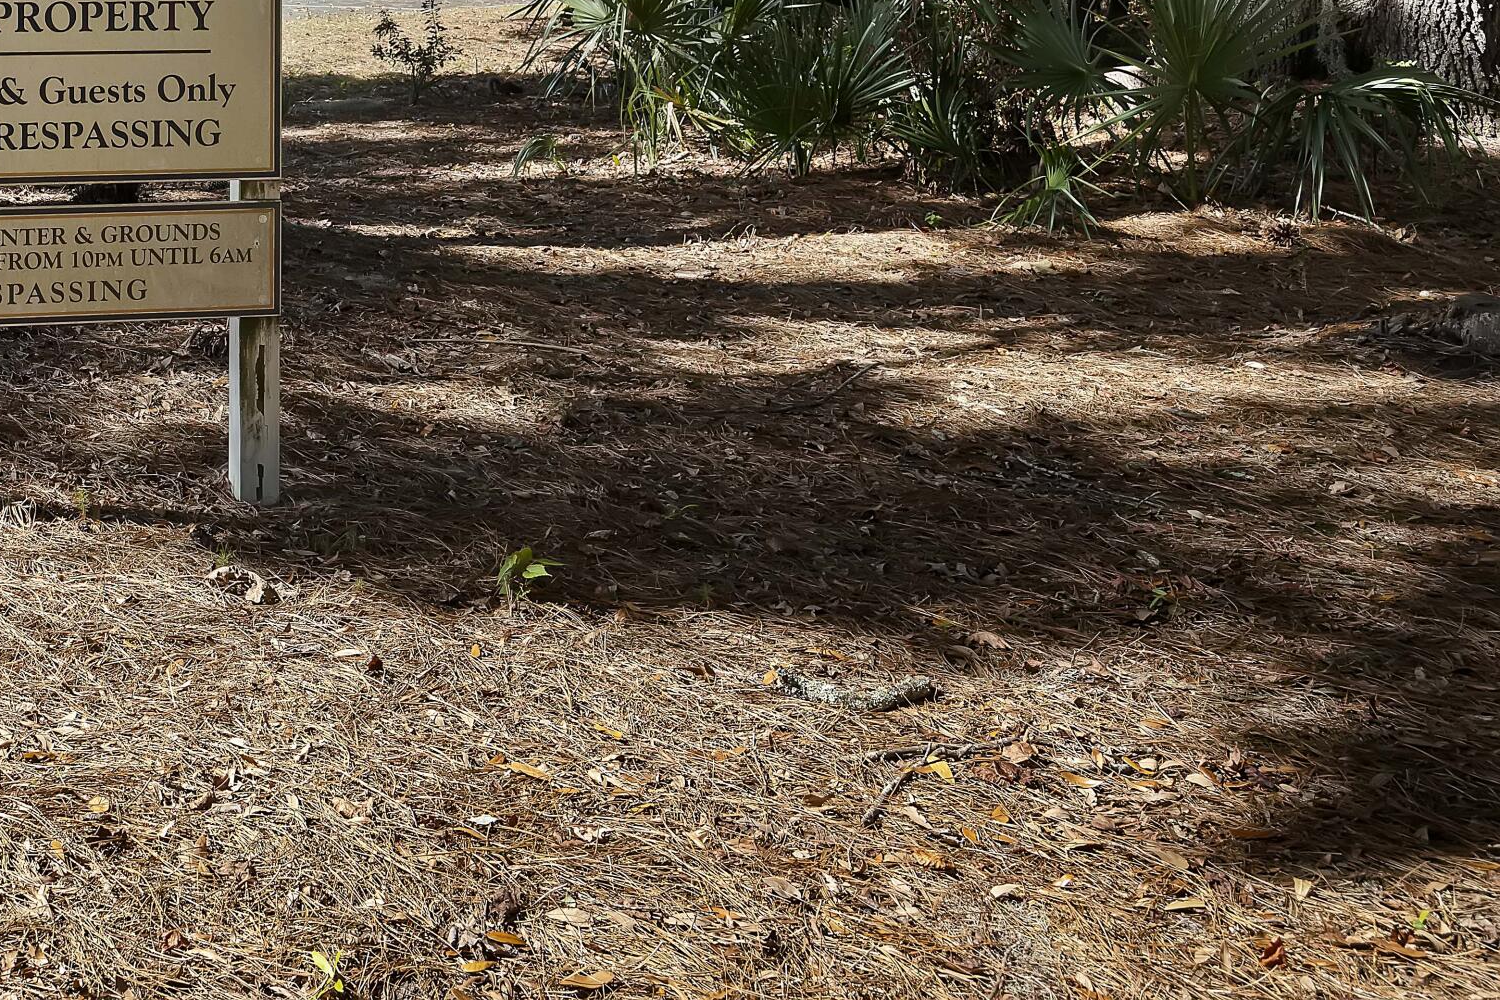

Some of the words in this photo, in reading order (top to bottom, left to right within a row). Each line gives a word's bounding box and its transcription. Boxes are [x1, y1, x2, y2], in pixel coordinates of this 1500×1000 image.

[39, 75, 146, 106] Guests
[157, 72, 237, 108] Only
[74, 226, 94, 245] &
[100, 222, 222, 244] GROUNDS
[71, 250, 124, 269] 10PM
[130, 246, 204, 268] UNTIL
[209, 246, 253, 265] 6AM
